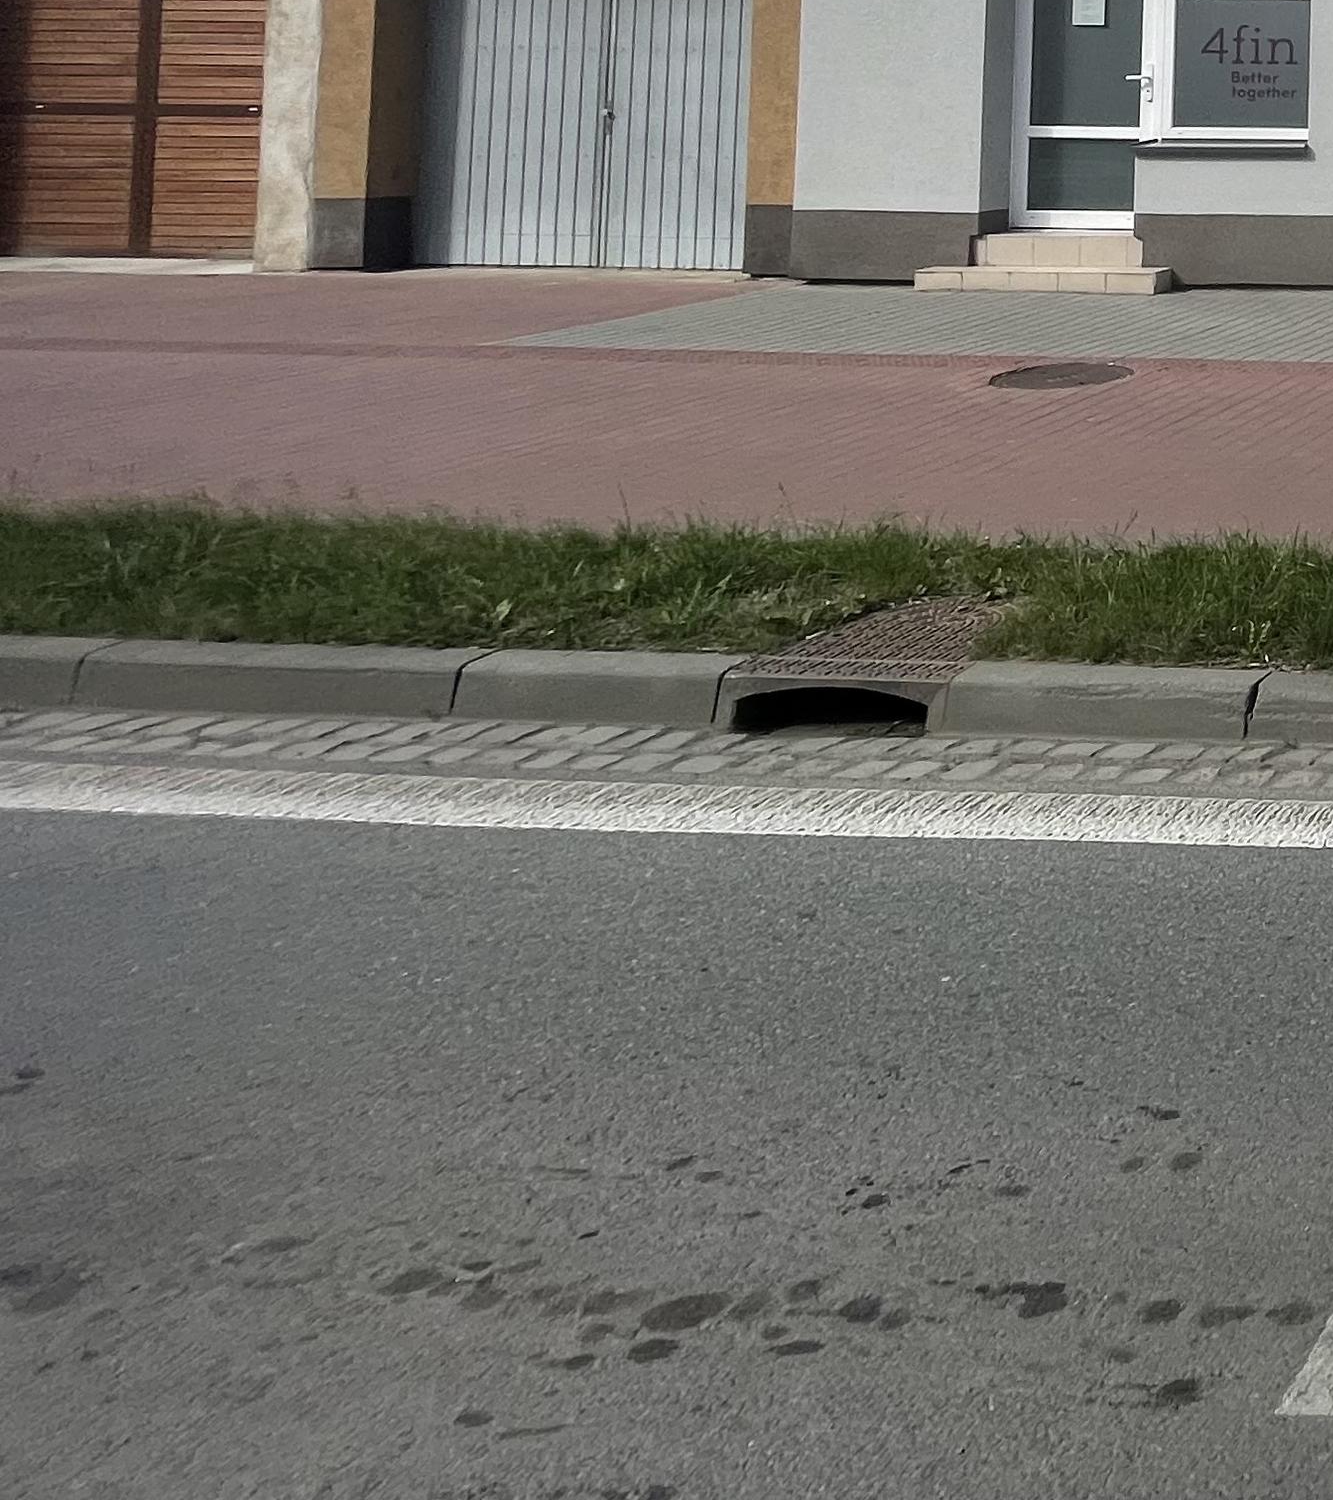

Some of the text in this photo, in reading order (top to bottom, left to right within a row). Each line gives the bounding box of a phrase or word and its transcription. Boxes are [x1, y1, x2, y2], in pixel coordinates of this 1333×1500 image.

[1200, 24, 1298, 66] 4fin
[1231, 70, 1279, 84] Better
[1231, 86, 1298, 102] together
